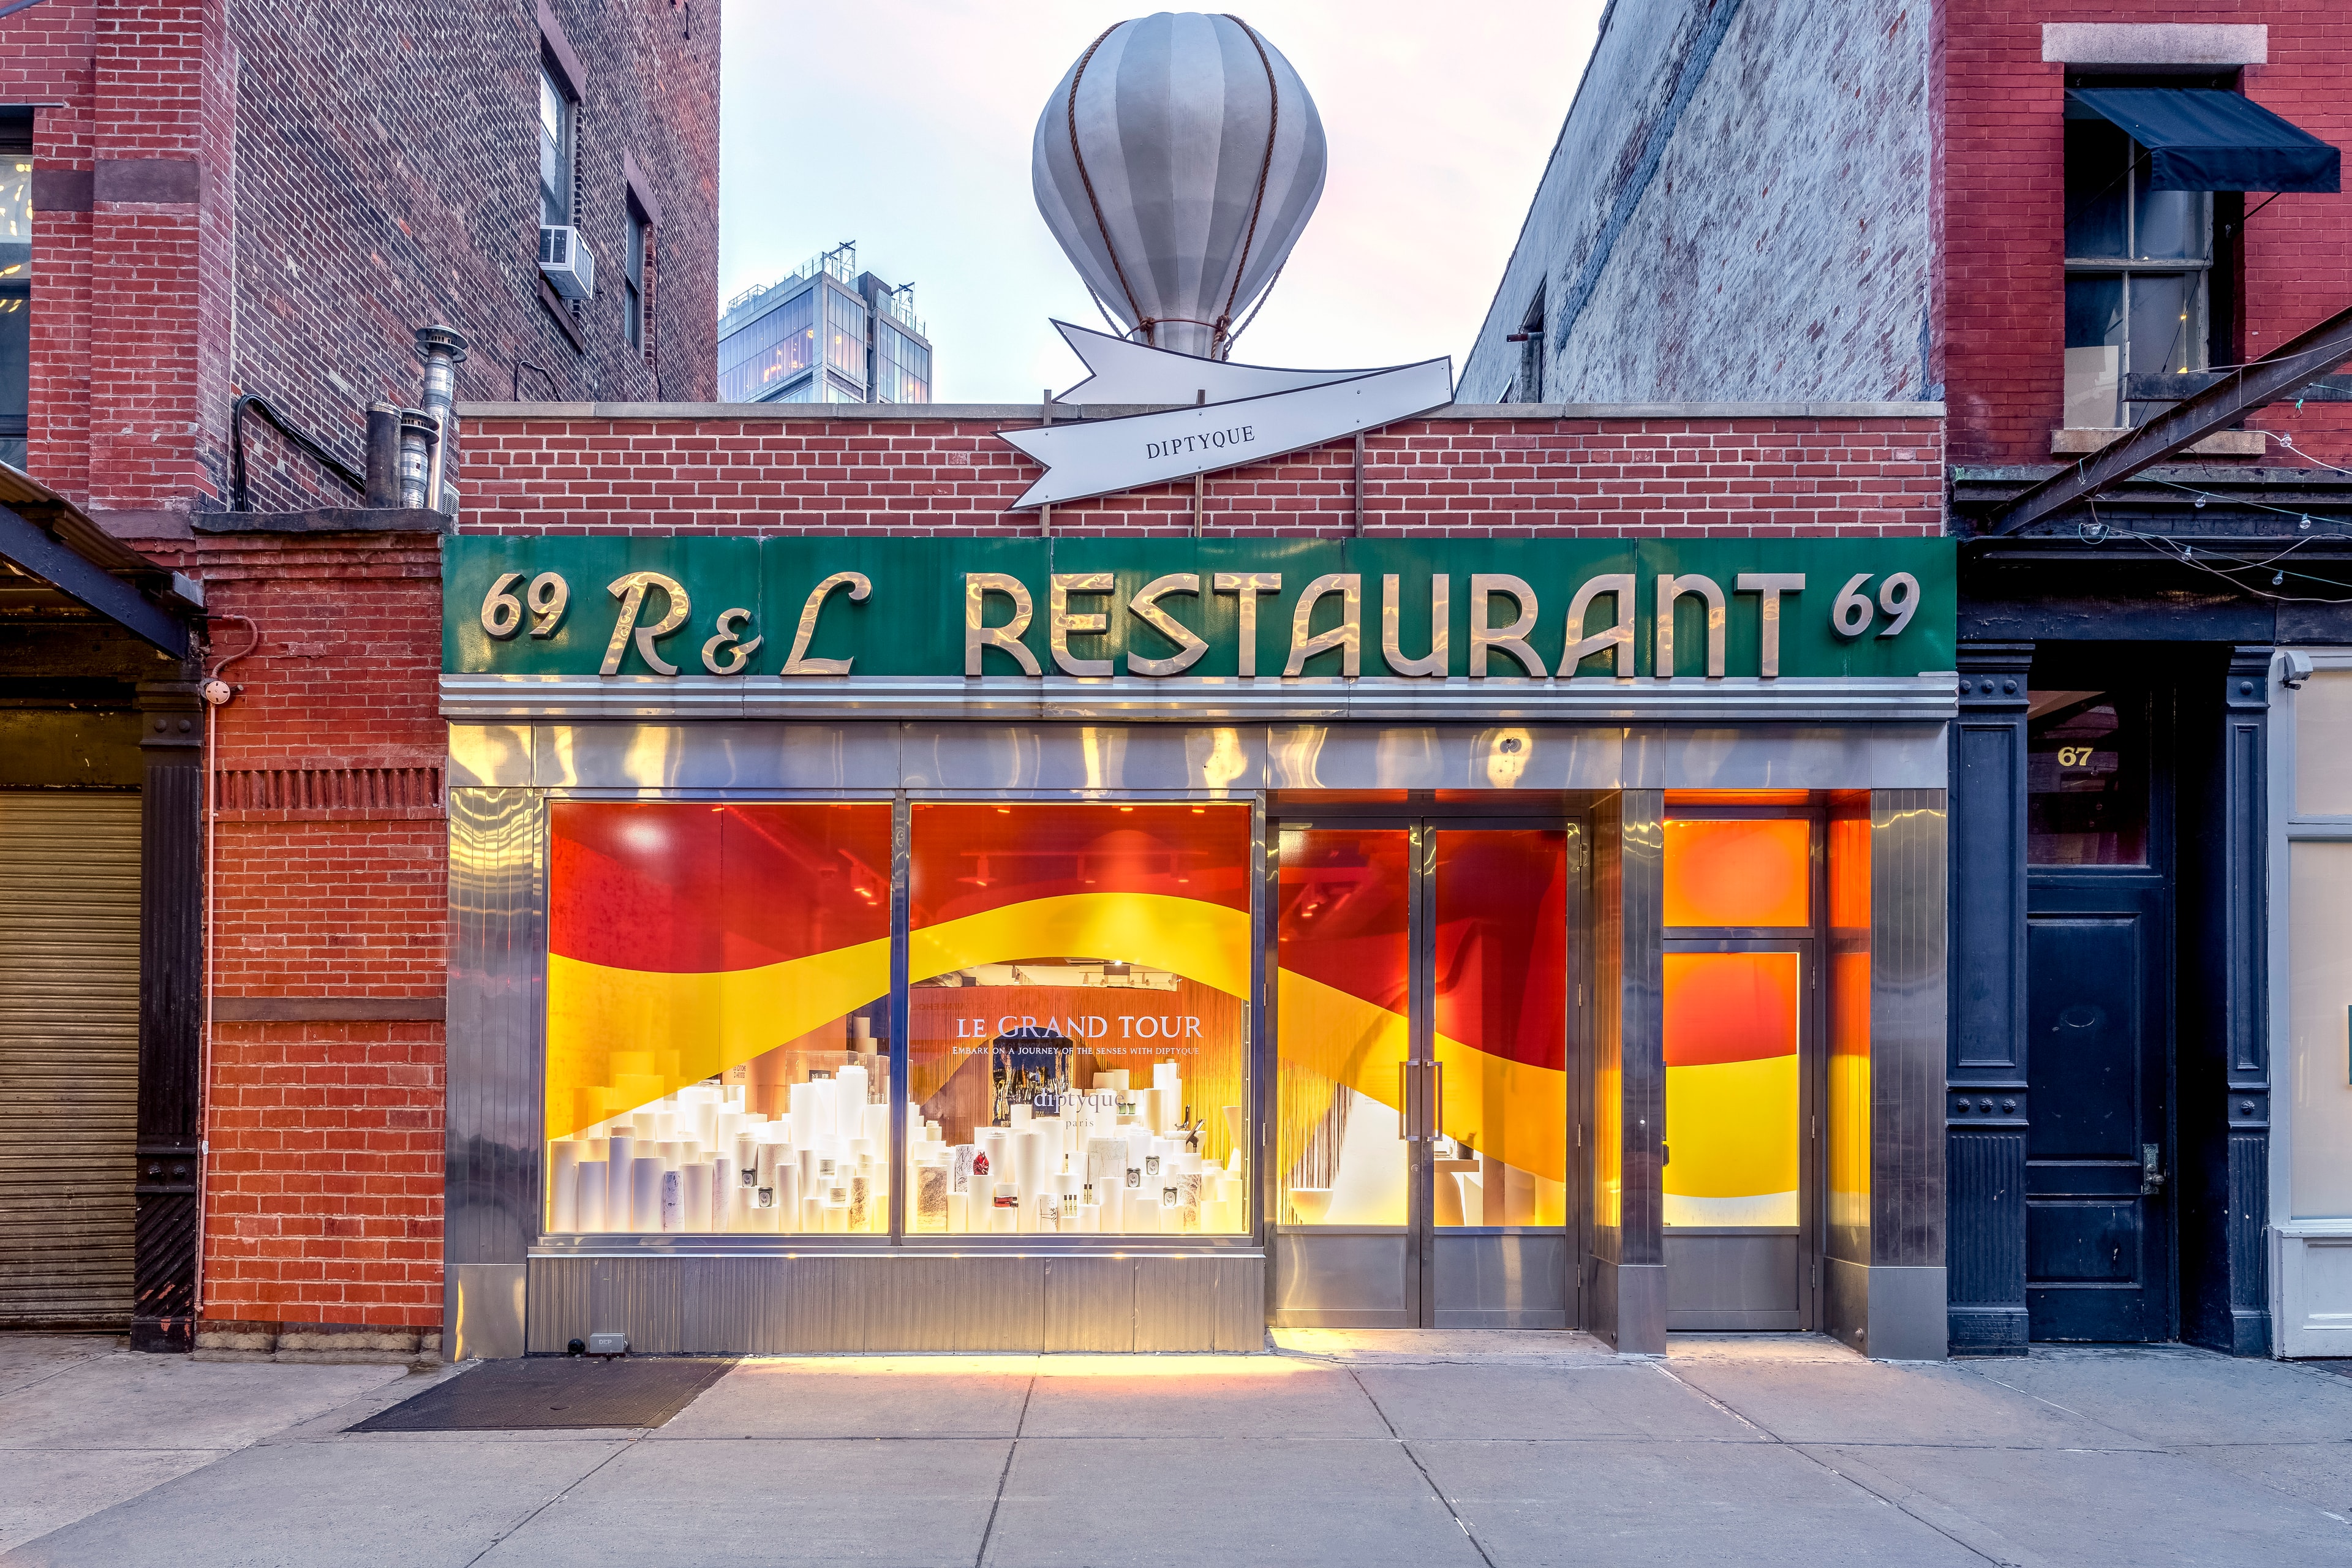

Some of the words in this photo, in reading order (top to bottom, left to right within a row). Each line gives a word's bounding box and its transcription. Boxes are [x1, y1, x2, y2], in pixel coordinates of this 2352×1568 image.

[1146, 425, 1256, 460] DIPTYQUE
[481, 571, 570, 640] 69
[599, 571, 691, 676] R
[701, 607, 764, 676] &
[780, 571, 873, 676] L
[964, 571, 1806, 677] RESTAURANT
[1829, 571, 1920, 641] 69
[2057, 746, 2094, 767] 67
[956, 1018, 987, 1038] LE
[998, 1015, 1107, 1038] GRAND
[1118, 1016, 1204, 1038] TOUR
[952, 1046, 989, 1055] EMBARK
[1034, 1087, 1125, 1114] diptyque
[1066, 1118, 1094, 1130] paris
